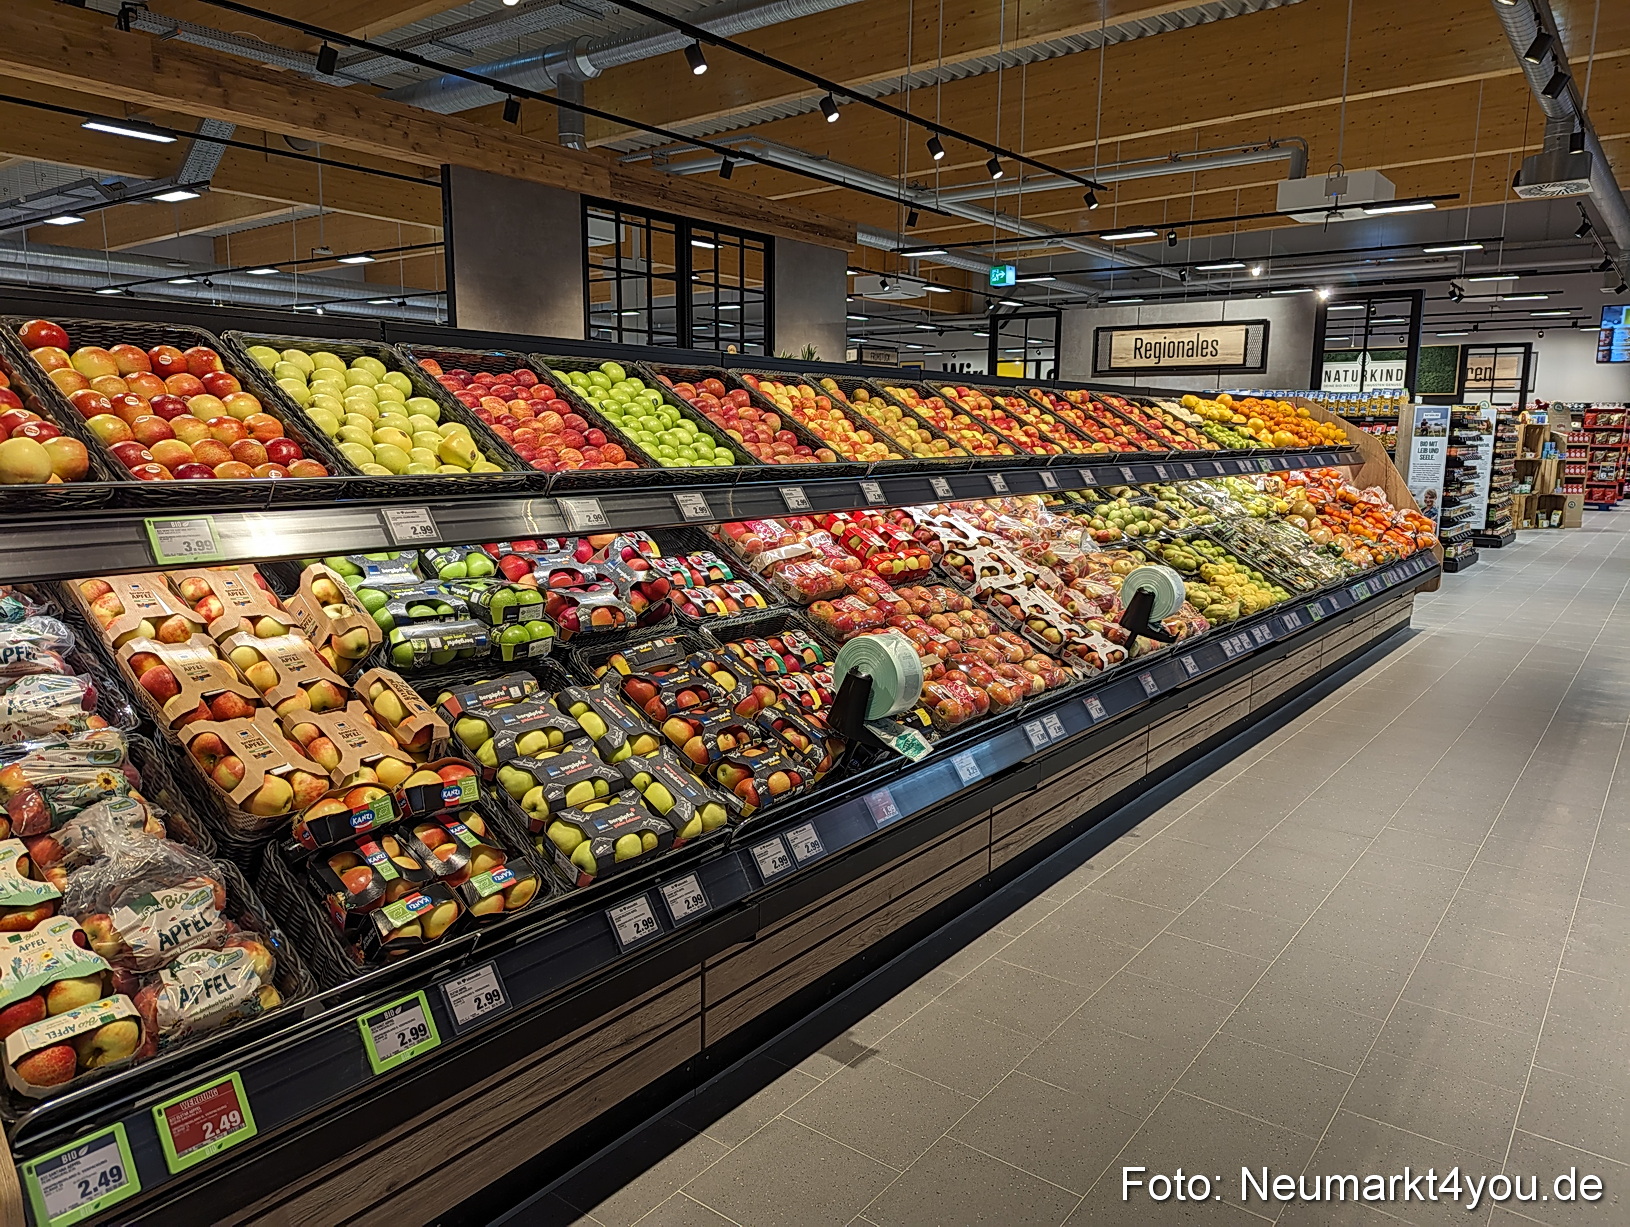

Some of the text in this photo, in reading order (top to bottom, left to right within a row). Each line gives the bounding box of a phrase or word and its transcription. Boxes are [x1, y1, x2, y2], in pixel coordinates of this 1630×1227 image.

[1133, 332, 1219, 365] Regionales
[1324, 368, 1404, 382] NATURKIND
[586, 513, 604, 523] 2.99
[410, 524, 433, 535] 2.99
[183, 540, 214, 552] 3.99
[442, 789, 460, 798] KANZI
[882, 804, 896, 818] 1.99
[352, 812, 373, 826] KANZI
[450, 824, 466, 833] KANZI
[804, 840, 820, 854] 2.99
[368, 852, 386, 863] KANZI
[772, 854, 789, 870] 2.99
[493, 869, 513, 882] KANZI
[161, 892, 189, 910] Bio
[407, 896, 430, 910] KANZI
[684, 893, 704, 910] 2.99
[158, 911, 212, 952] ÄPFEL
[633, 916, 655, 934] 2.99
[23, 931, 40, 941] Bio
[179, 973, 236, 1009] ÄPFEL
[474, 989, 501, 1011] 2.99
[383, 1009, 394, 1020] BIO
[78, 1016, 98, 1028] Bio
[397, 1022, 428, 1048] 2.99
[179, 1088, 219, 1111] WERBUNG
[202, 1110, 241, 1140] 2.49
[61, 1150, 77, 1164] BIO
[77, 1165, 123, 1199] 2.49
